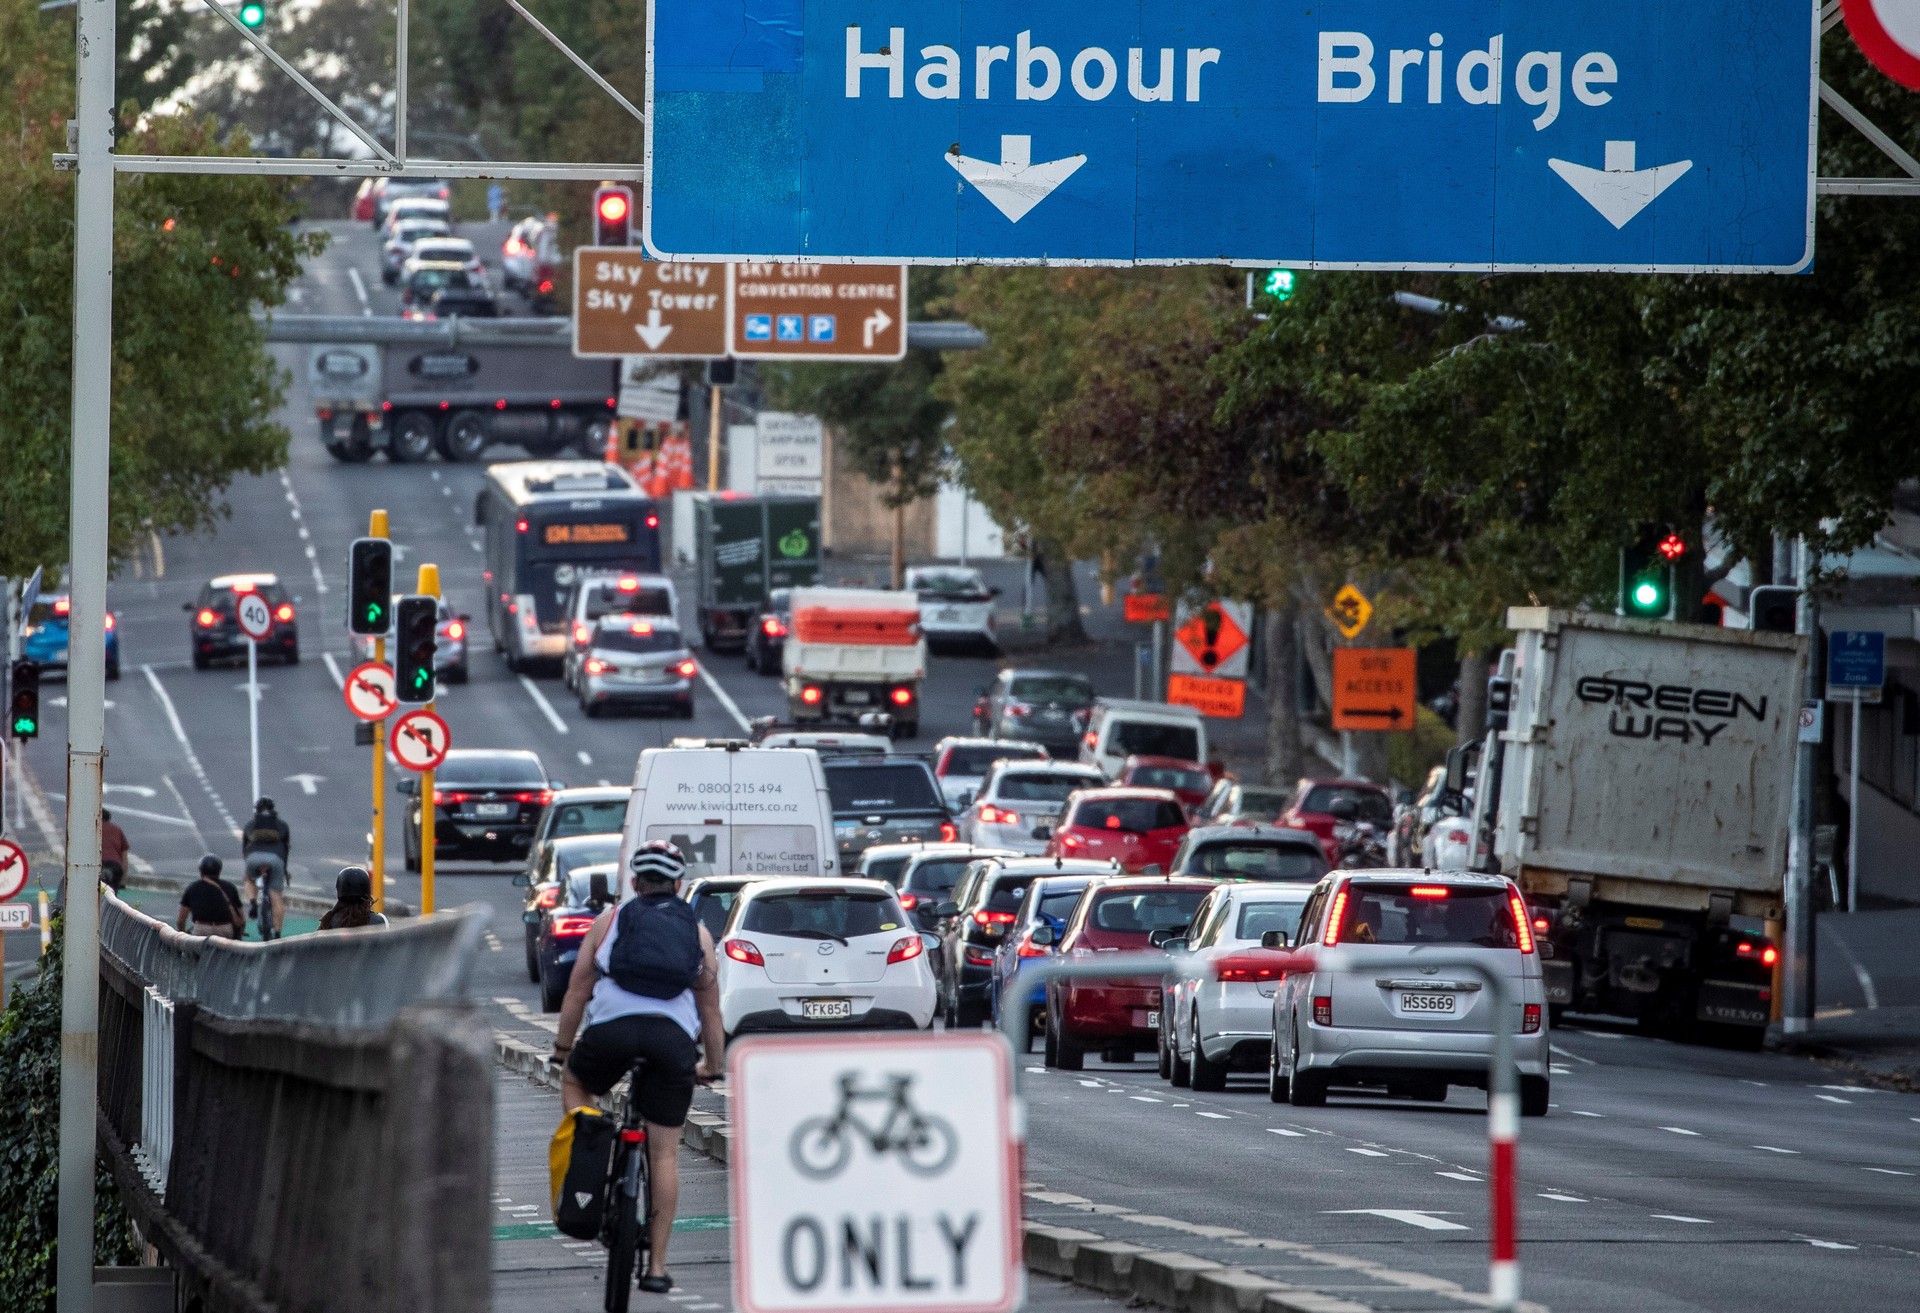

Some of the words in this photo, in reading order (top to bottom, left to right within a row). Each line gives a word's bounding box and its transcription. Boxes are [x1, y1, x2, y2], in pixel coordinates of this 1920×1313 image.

[846, 26, 1222, 102] Harbour
[1317, 31, 1618, 132] Bridge
[596, 262, 642, 286] Sky
[657, 262, 710, 287] City
[739, 264, 773, 278] SKY
[781, 264, 823, 278] CITY
[739, 284, 832, 298] CONVENTION
[838, 284, 896, 299] CENTRE
[586, 290, 633, 313] Sky
[650, 290, 718, 310] Tower
[245, 605, 265, 624] 40
[1345, 680, 1404, 694] ACCESS
[1575, 676, 1768, 722] GREEN
[1608, 710, 1728, 746] WAY
[677, 782, 695, 793] Ph:
[698, 783, 731, 794] 0800
[734, 783, 755, 794] 215
[758, 783, 783, 794] 494
[666, 801, 798, 812] www.kiwicutters.co.nz
[739, 852, 752, 861] A1
[757, 851, 777, 861] Kiwi
[779, 851, 815, 861] Cutters
[746, 863, 753, 872] &
[757, 862, 791, 872] Drillers
[793, 862, 809, 872] Ltd
[804, 1003, 849, 1017] KFK854
[1403, 996, 1454, 1010] HSS669
[1706, 1006, 1765, 1021] VOLVO
[780, 1211, 979, 1292] ONLY
